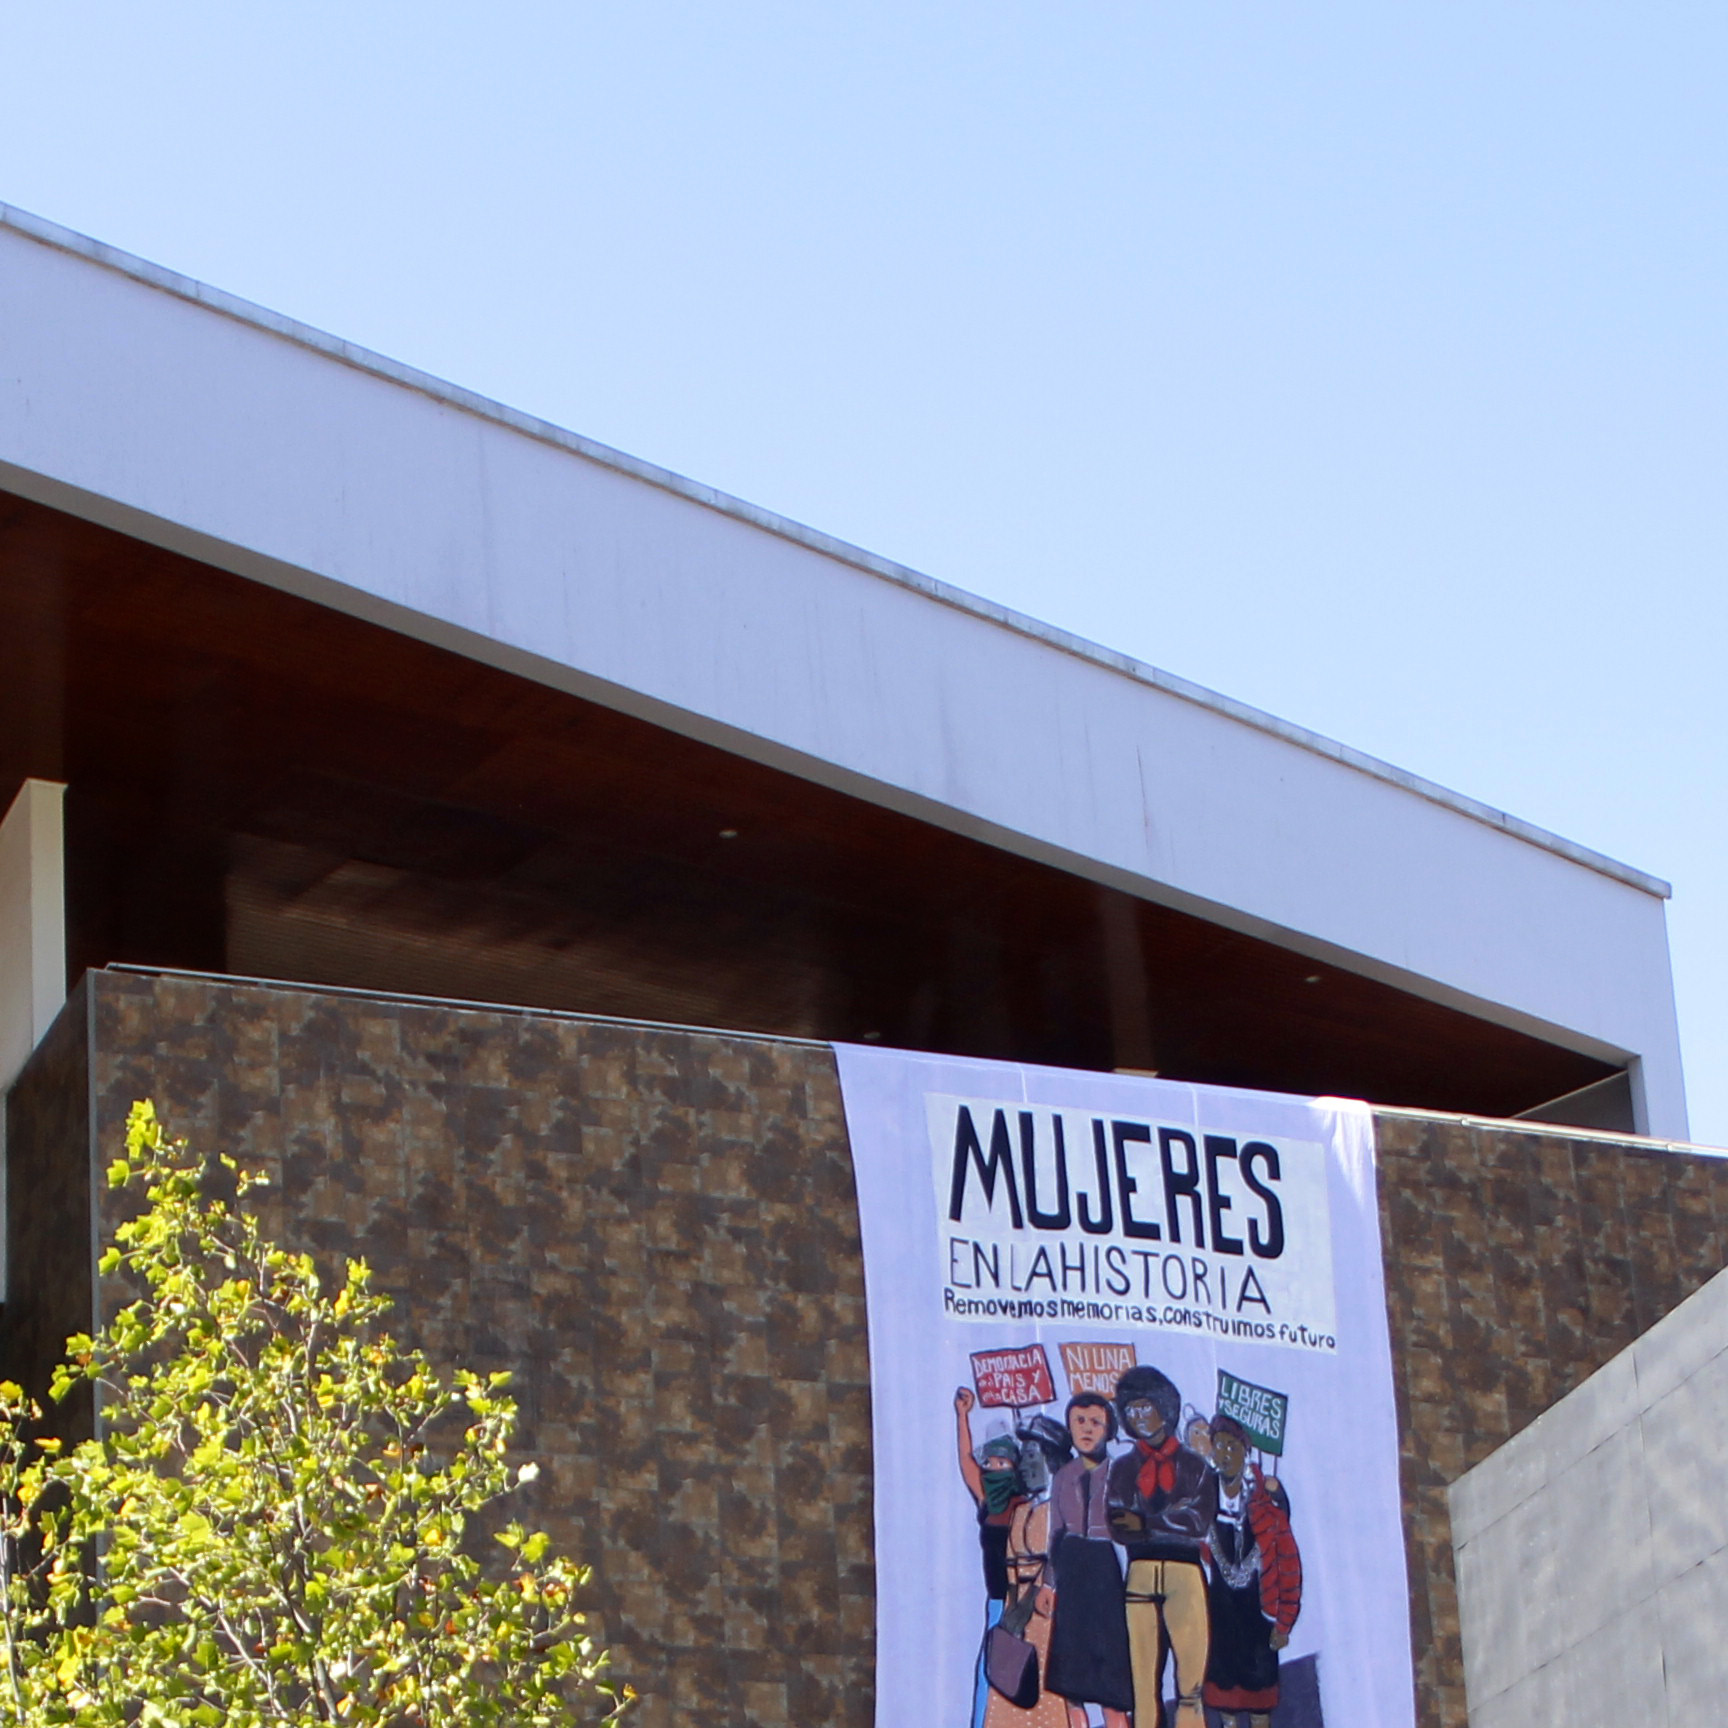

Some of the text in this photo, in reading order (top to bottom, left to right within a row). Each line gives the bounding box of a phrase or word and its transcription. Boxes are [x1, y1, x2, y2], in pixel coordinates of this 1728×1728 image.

[949, 1105, 1285, 1260] MUJERES
[950, 1236, 1272, 1315] EN LA HISTORIA
[944, 1287, 1058, 1319] Removemos
[1279, 1323, 1336, 1350] futuro
[1066, 1346, 1132, 1371] NI UNA
[1001, 1384, 1041, 1405] CASA
[1071, 1372, 1120, 1396] MENOS
[1221, 1376, 1282, 1419] LIBRES
[1224, 1400, 1281, 1439] SEGURAS
